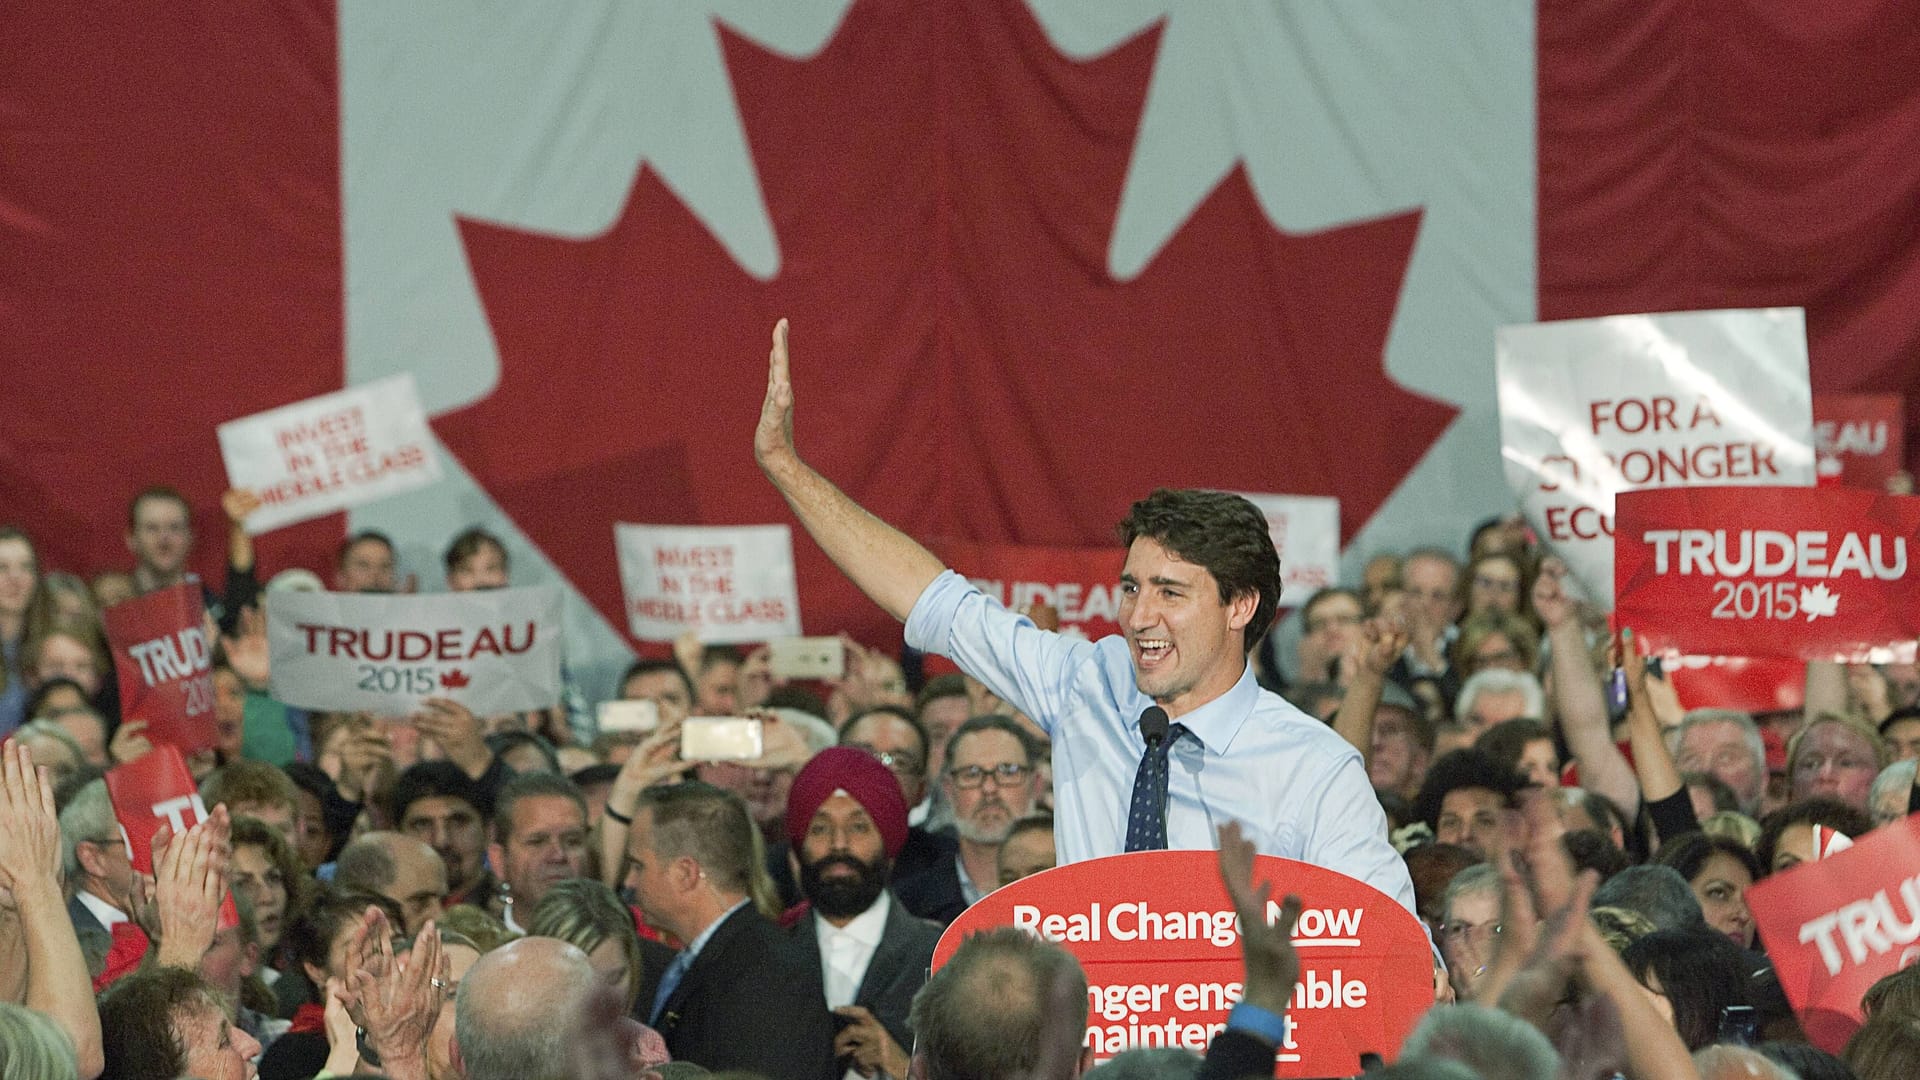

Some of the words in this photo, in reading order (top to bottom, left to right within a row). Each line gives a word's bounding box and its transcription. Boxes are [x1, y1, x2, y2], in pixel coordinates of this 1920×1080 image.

[1589, 396, 1679, 435] FOR
[1690, 395, 1722, 429] A
[1813, 420, 1888, 456] EAU
[1643, 529, 1907, 580] TRUDEAU
[1712, 581, 1798, 620] 2015
[296, 621, 535, 662] TRUDEAU
[358, 664, 434, 694] 2015
[1013, 902, 1100, 943] Real
[1107, 902, 1243, 947] Chang
[1174, 970, 1367, 1011] ensble
